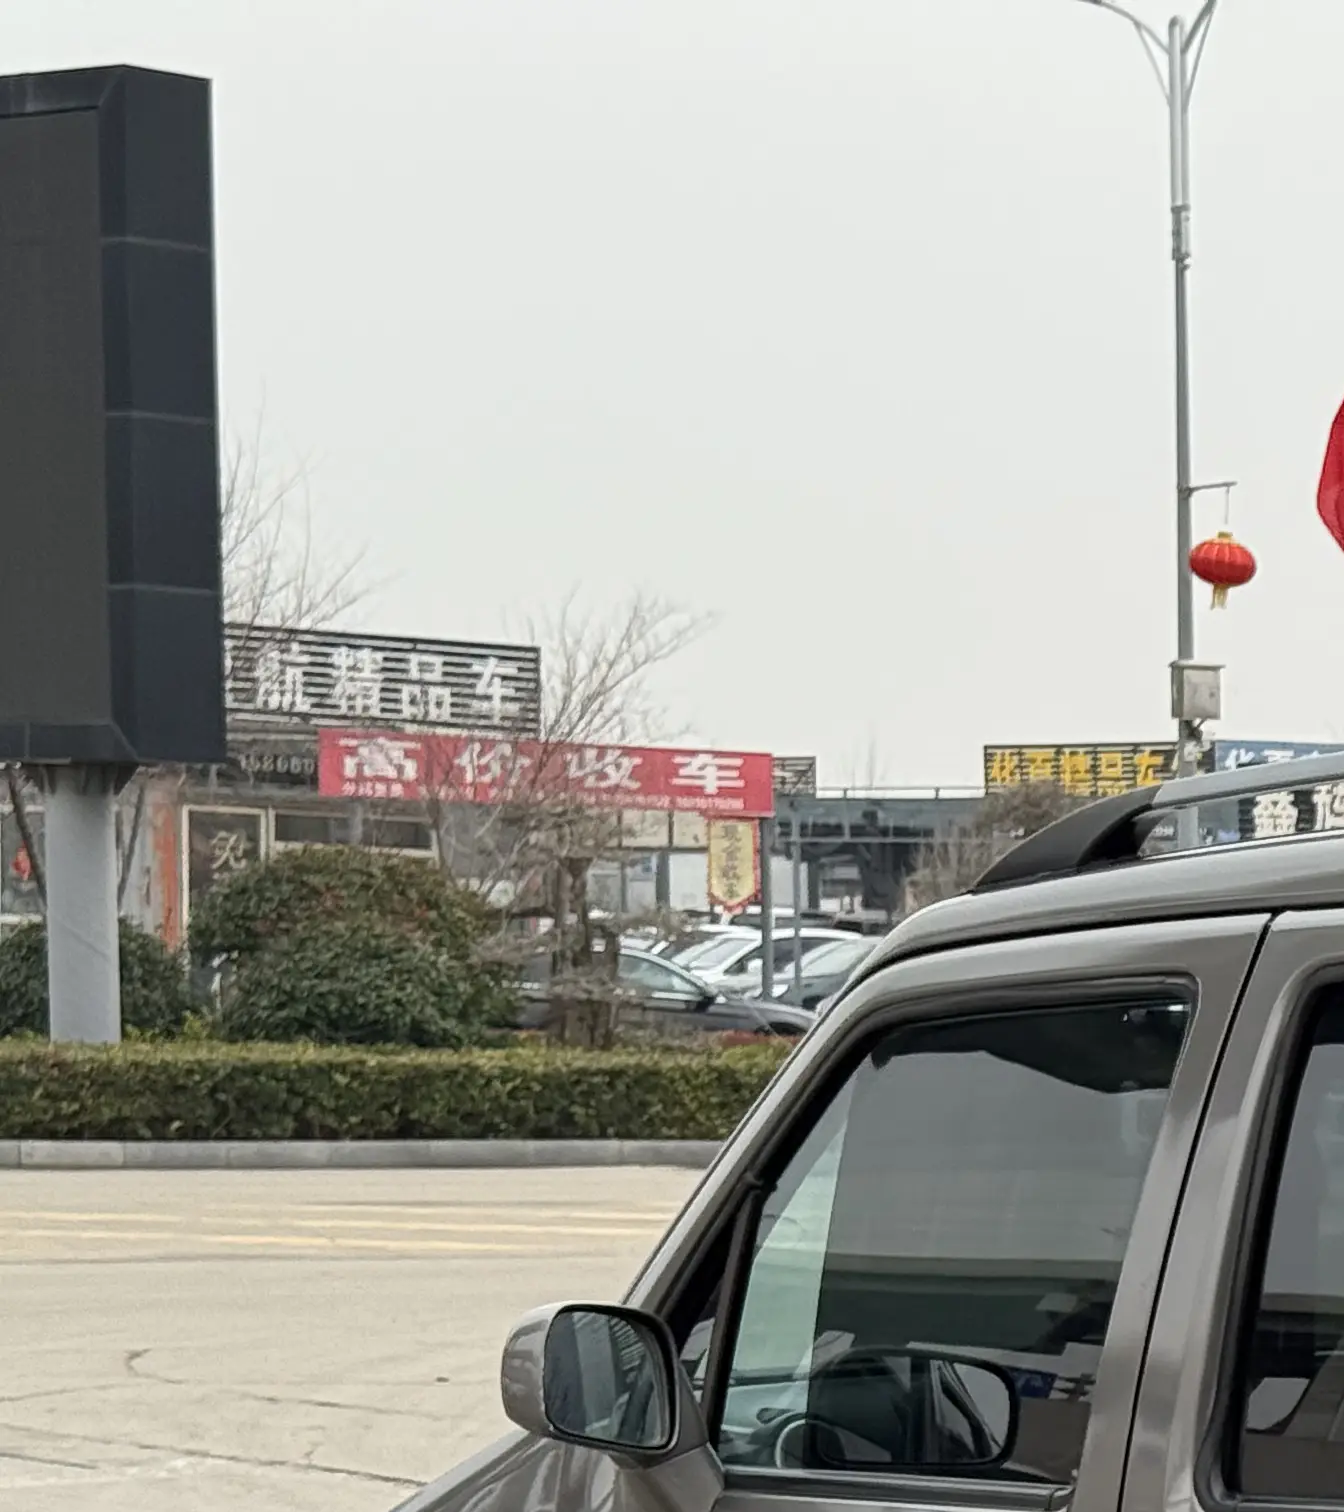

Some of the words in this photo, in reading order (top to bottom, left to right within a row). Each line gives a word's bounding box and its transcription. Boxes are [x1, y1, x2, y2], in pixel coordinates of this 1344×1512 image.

[224, 643, 522, 726] 航精品车
[338, 736, 746, 796] 高价收车
